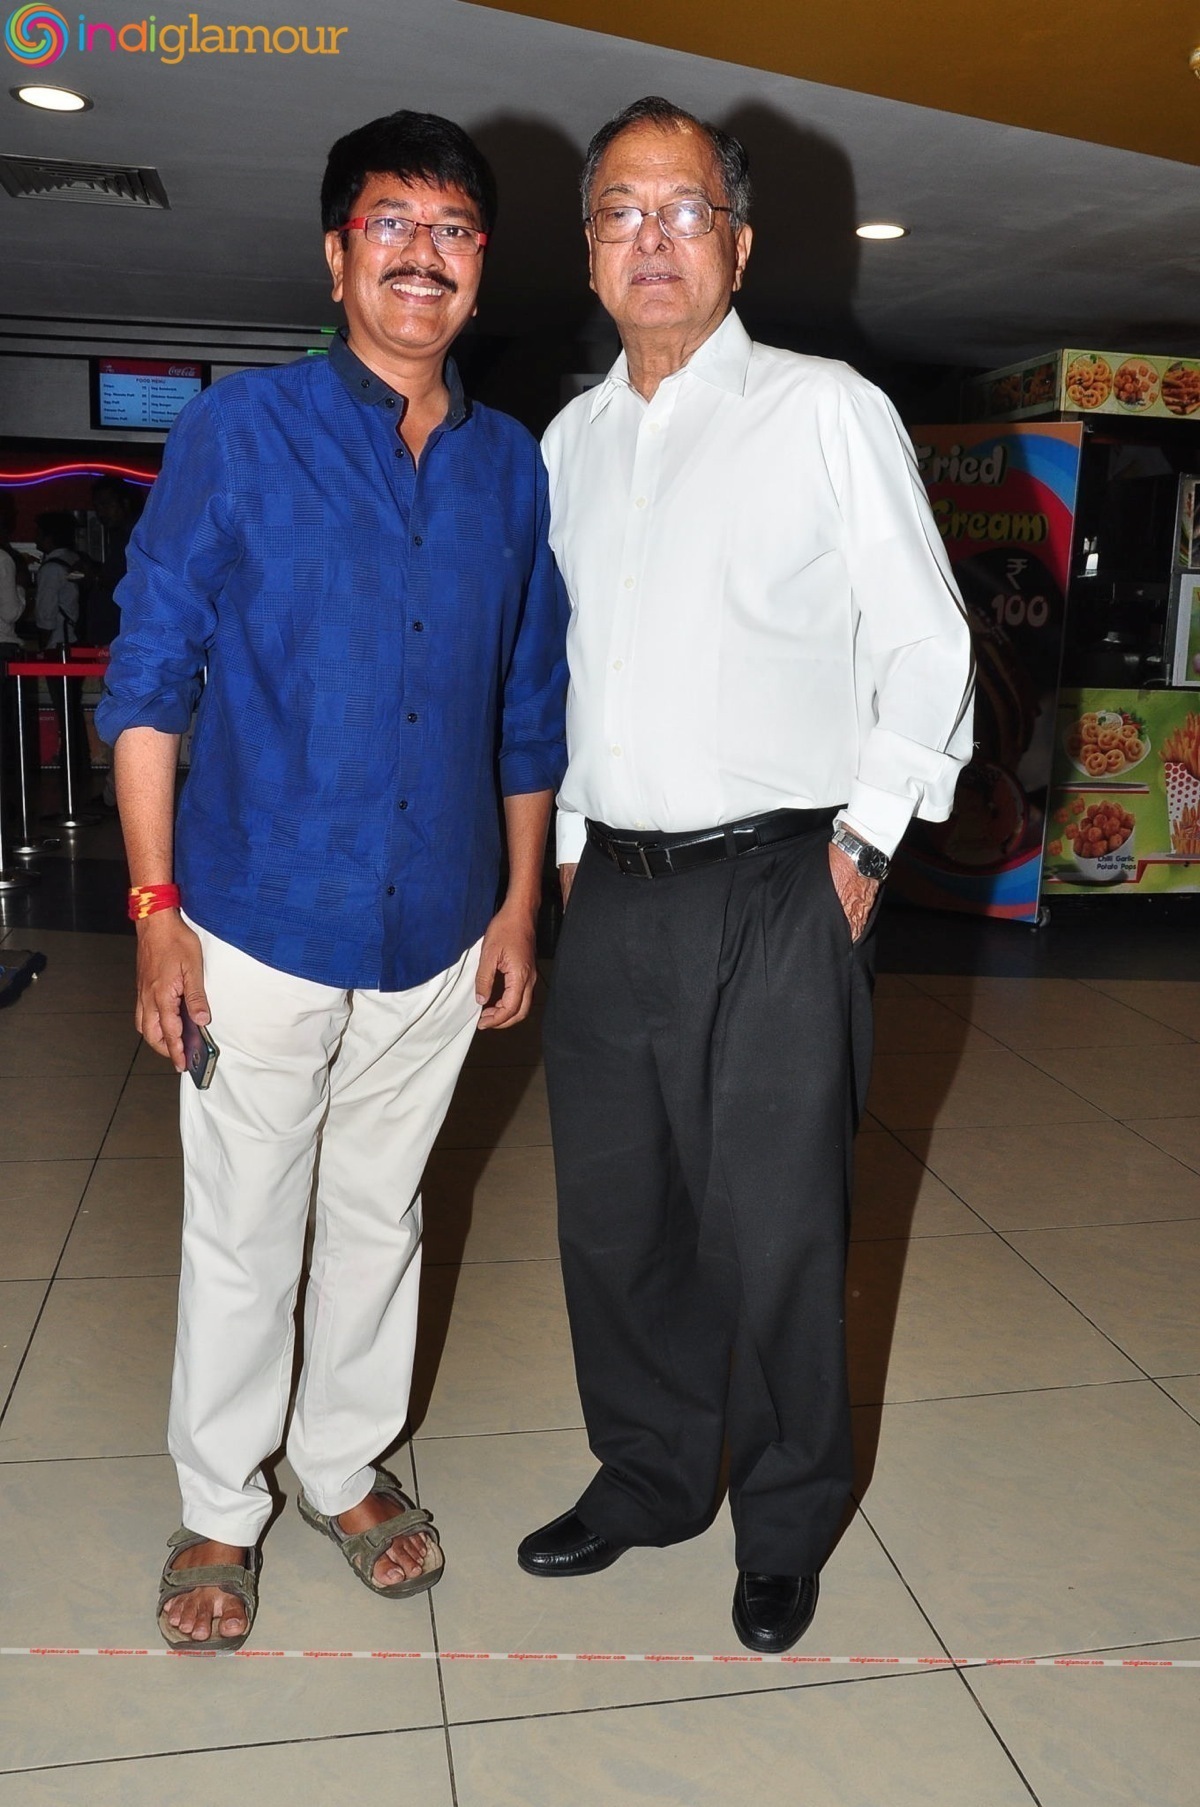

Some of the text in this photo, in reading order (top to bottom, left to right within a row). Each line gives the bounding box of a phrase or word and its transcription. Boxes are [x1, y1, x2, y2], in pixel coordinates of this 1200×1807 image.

[931, 500, 1047, 542] Cream
[992, 595, 1048, 628] 100
[1115, 854, 1135, 862] Garlic
[1120, 863, 1136, 871] Pops
